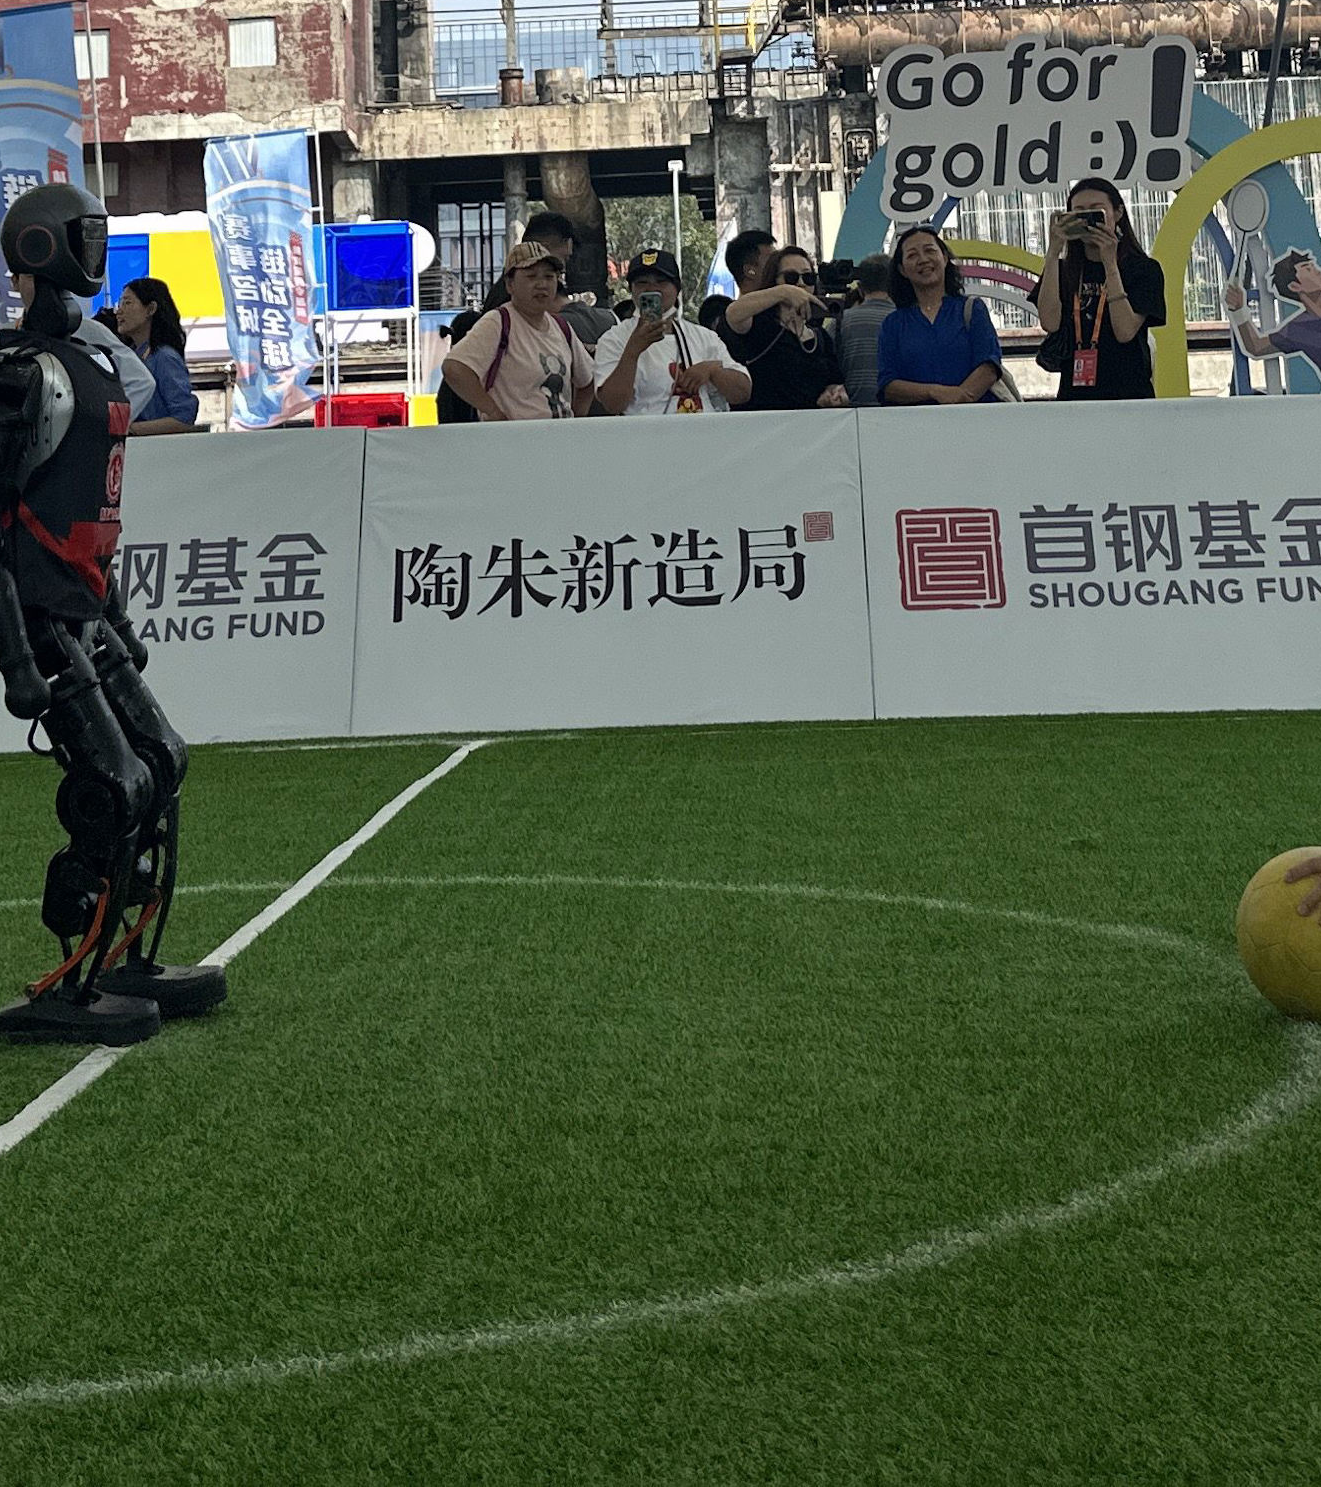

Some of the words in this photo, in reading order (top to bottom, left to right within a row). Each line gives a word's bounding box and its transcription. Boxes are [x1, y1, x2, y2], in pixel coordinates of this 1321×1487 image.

[886, 53, 984, 111] Go
[1007, 41, 1119, 105] for
[889, 120, 1062, 213] gold
[392, 523, 807, 623] 陶朱新造局
[1028, 575, 1245, 609] SHOUGANG
[227, 610, 326, 640] FUND
